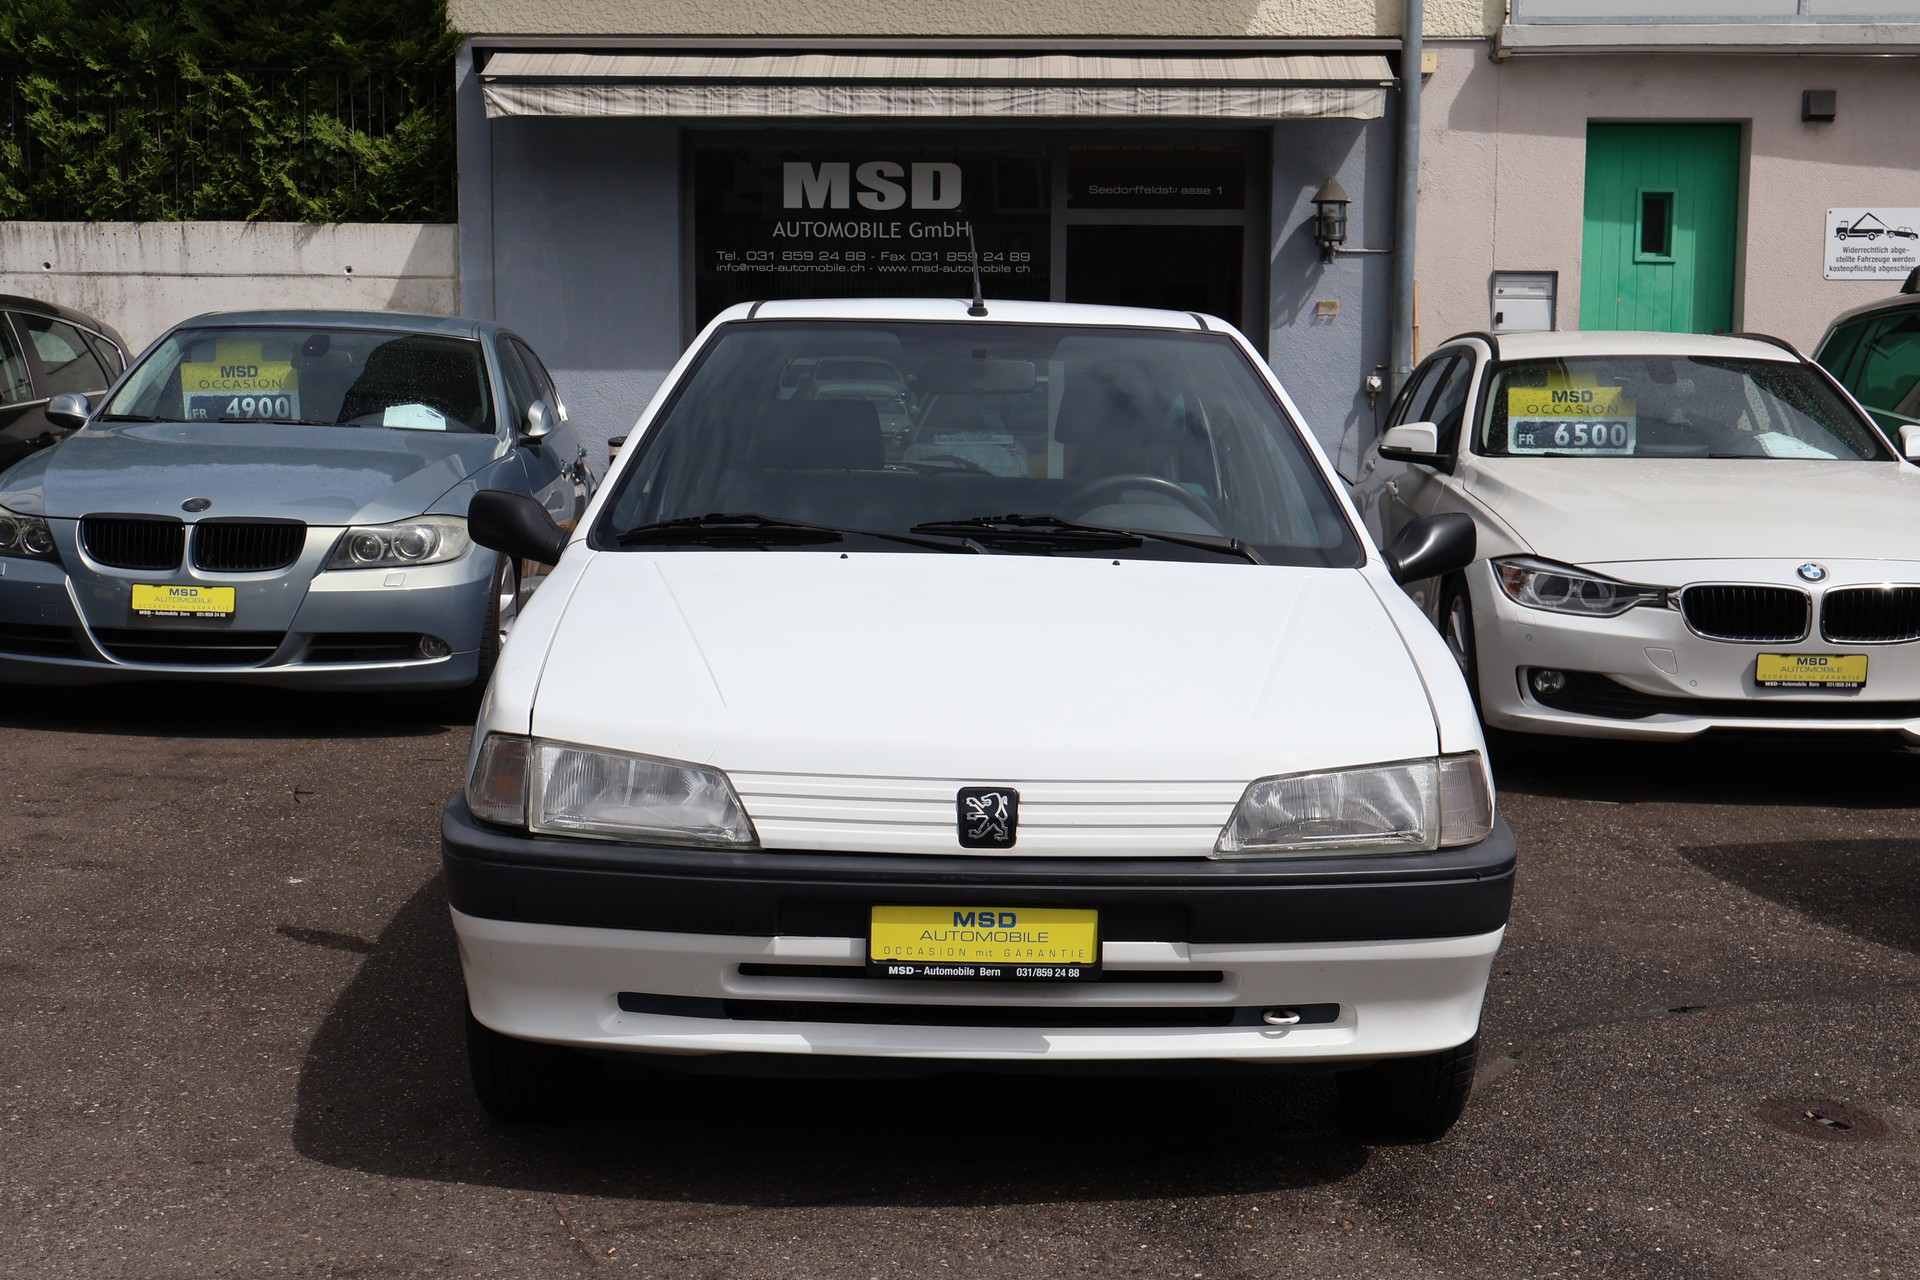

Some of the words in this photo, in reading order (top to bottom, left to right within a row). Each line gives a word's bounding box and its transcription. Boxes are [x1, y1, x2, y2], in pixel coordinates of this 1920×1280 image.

[783, 161, 962, 210] MSD
[1216, 186, 1223, 194] 1
[772, 221, 902, 239] AUTOMOBILE
[909, 221, 969, 238] GmbH
[1842, 246, 1889, 254] Widerrechtlich
[1890, 246, 1910, 255] abge-
[716, 251, 740, 261] Tel.
[746, 251, 774, 261] 031
[782, 251, 814, 261] 859
[818, 251, 840, 261] 24
[845, 251, 866, 261] 88
[880, 252, 906, 261] Fax
[910, 252, 939, 262] 031
[946, 252, 977, 262] 859
[983, 252, 1004, 262] 24
[1009, 252, 1031, 262] 89
[1836, 255, 1855, 263] stellte
[1857, 255, 1890, 264] Fahrzeuge
[716, 263, 866, 273] info@msd-automobile.ch
[1829, 265, 1877, 273] kostenpflichtig
[1878, 265, 1915, 273] abgeschlep
[220, 365, 258, 378] MSD
[199, 379, 282, 389] OCCASION
[1551, 390, 1594, 403] MSD
[192, 408, 208, 419] FR
[225, 397, 290, 419] 4900
[1526, 404, 1618, 414] OCCASION
[1518, 434, 1535, 445] FR
[1554, 423, 1626, 446] 6500
[169, 588, 198, 597] MSD
[154, 596, 213, 604] AUTOMOBILE
[1797, 657, 1828, 666] MSD
[953, 911, 1017, 928] MSD
[919, 930, 1049, 943] AUTOMOBILE
[884, 946, 966, 957] OCCASION
[976, 949, 993, 957] mit
[1004, 949, 1085, 958] GARANTIE
[923, 966, 975, 976] Automobile
[980, 967, 1001, 976] Bern
[1016, 968, 1054, 978] 031/859
[1055, 968, 1067, 977] 24
[1068, 968, 1080, 978] 88
